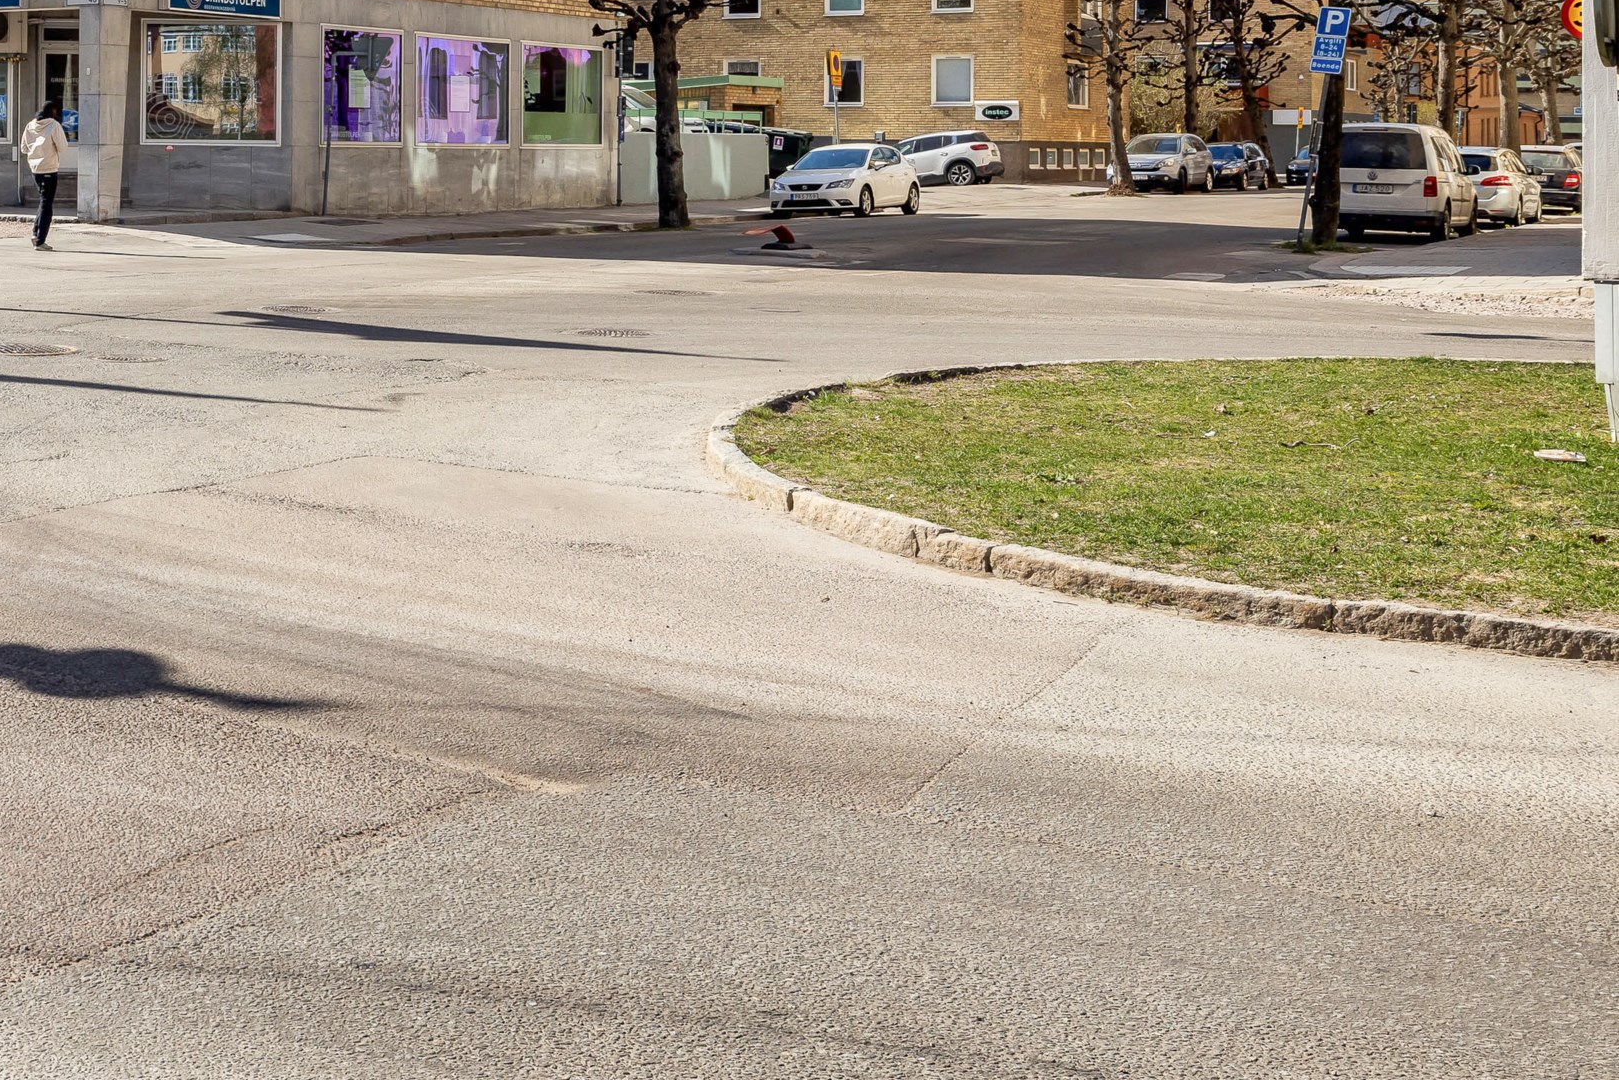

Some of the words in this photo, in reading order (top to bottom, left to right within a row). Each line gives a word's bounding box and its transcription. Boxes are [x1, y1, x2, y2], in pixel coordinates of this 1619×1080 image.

[1325, 10, 1345, 33] P
[1319, 37, 1342, 45] Avgift
[1312, 61, 1340, 70] Boende
